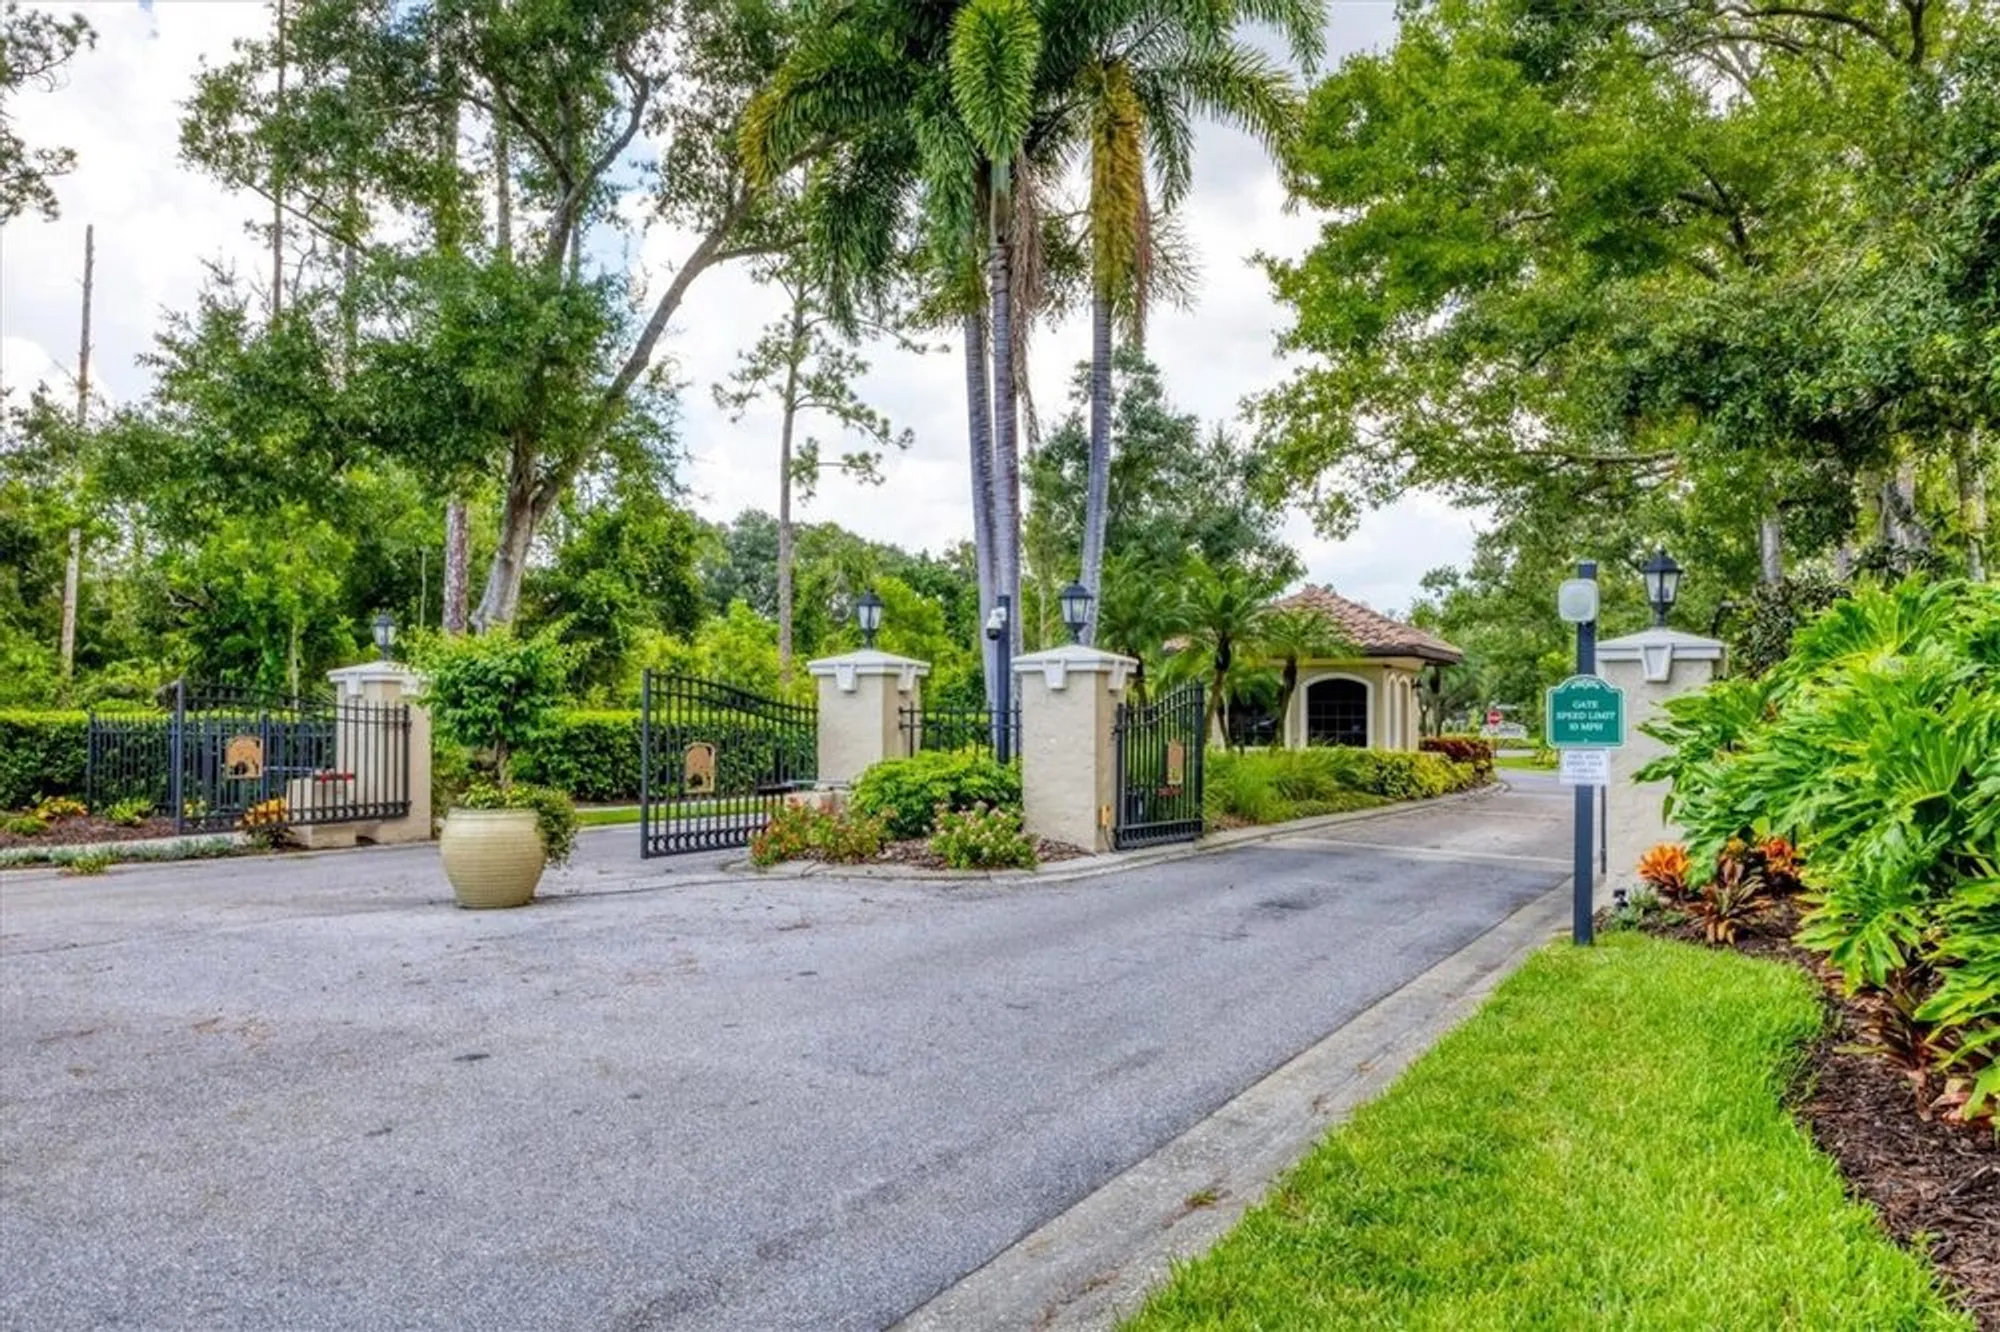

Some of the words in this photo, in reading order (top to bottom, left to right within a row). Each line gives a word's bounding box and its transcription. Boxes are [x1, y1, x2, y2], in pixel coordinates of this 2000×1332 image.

[1572, 700, 1599, 709] GATE
[1556, 711, 1587, 720] SPEED
[1588, 711, 1616, 720] LIMIT
[1568, 722, 1579, 731] 10
[1580, 722, 1603, 731] MPH
